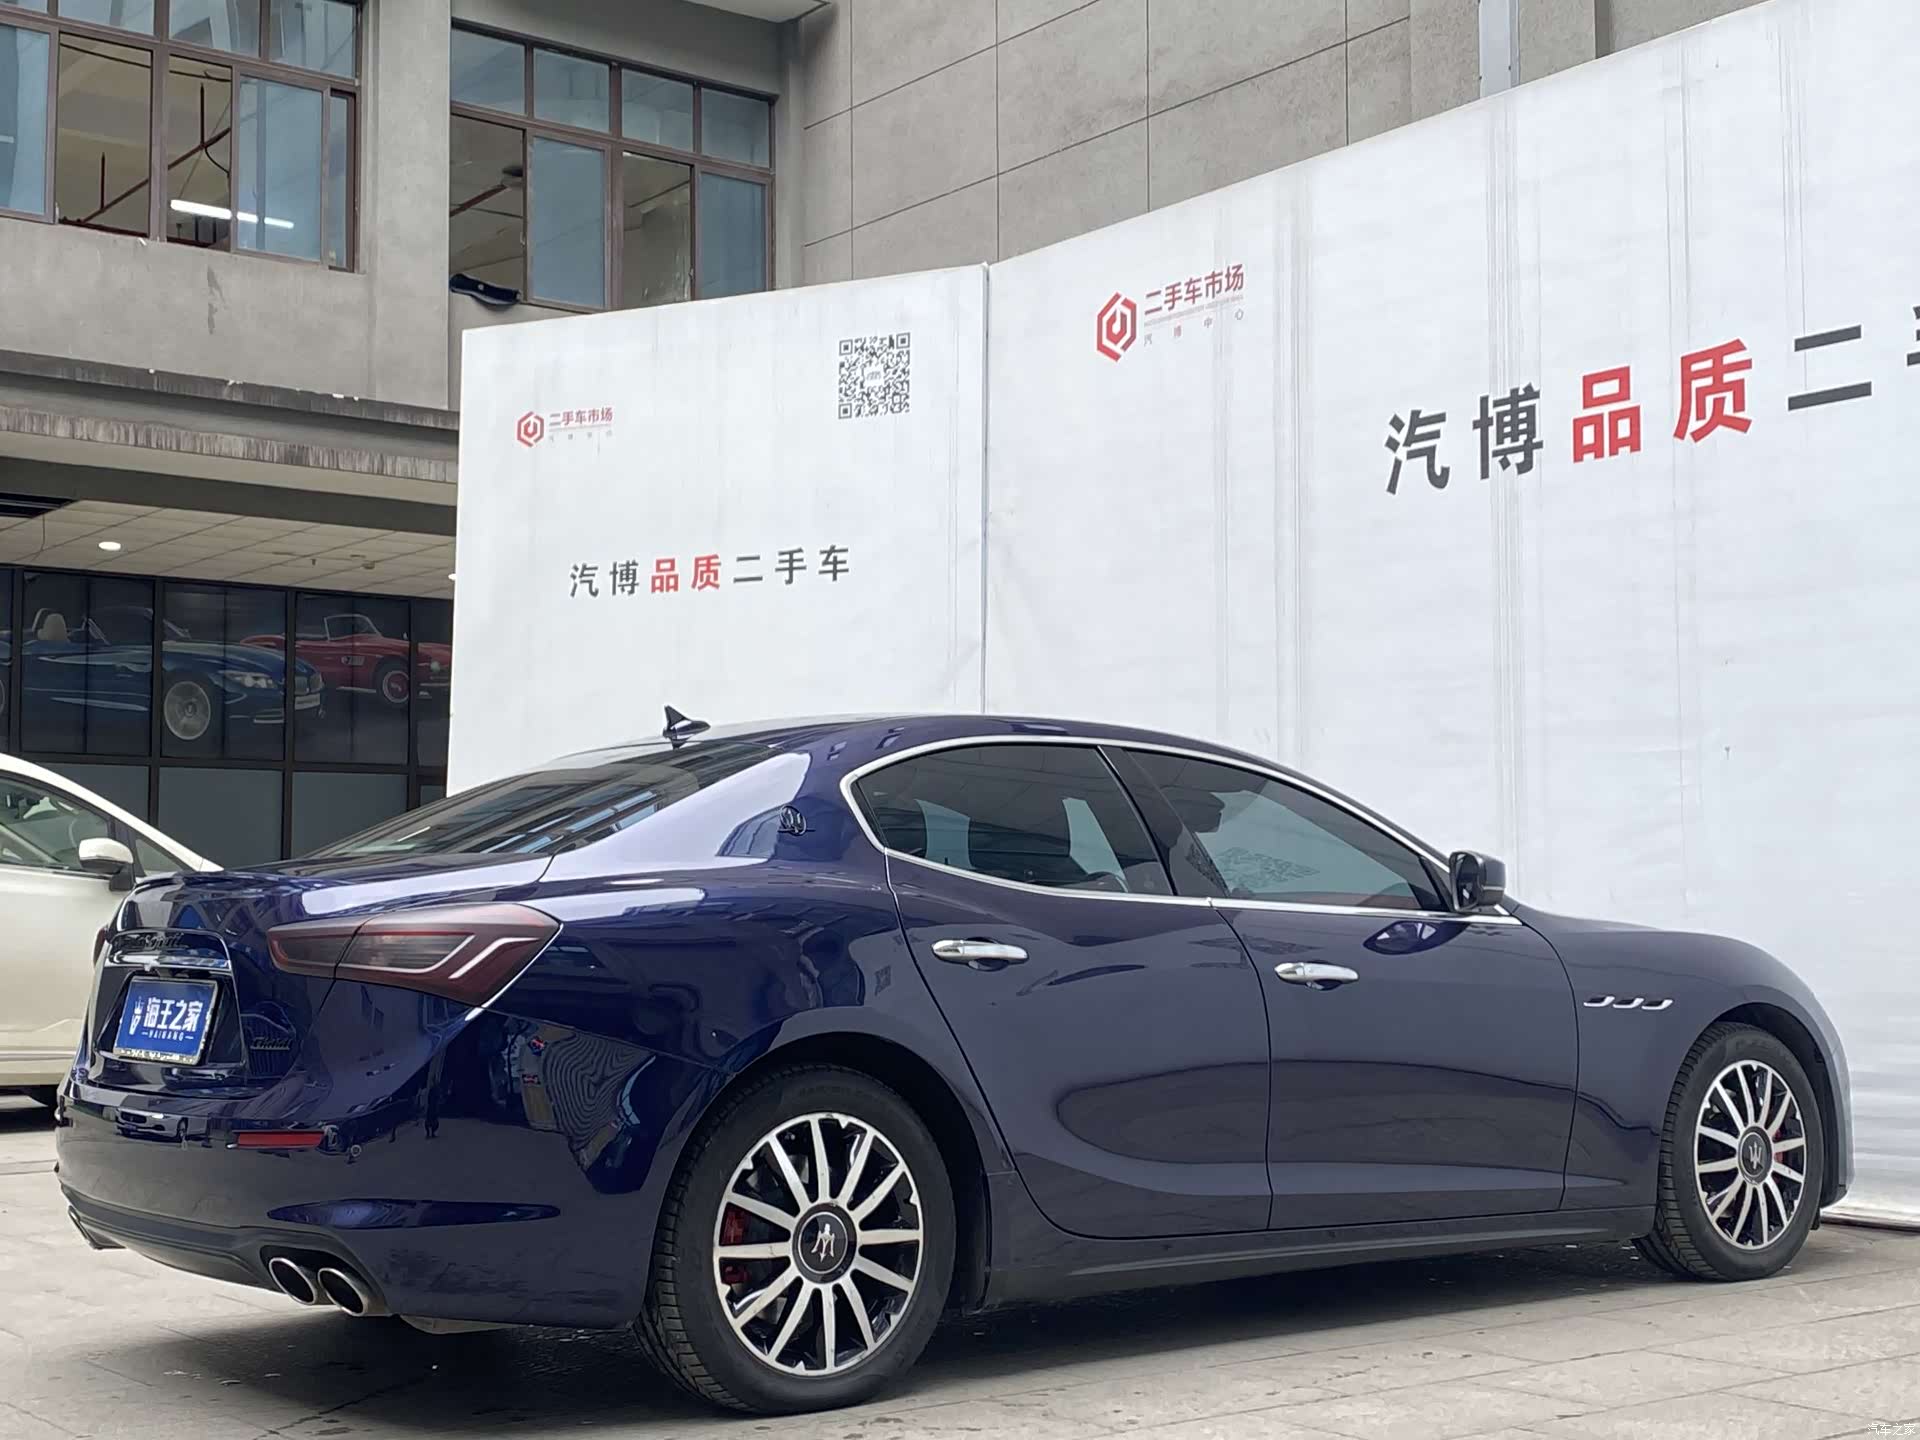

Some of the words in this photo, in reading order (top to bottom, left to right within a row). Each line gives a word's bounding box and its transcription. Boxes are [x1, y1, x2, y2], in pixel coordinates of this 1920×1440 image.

[1144, 263, 1244, 317] 二手车市场
[549, 406, 613, 426] 二手车市场
[1384, 305, 1920, 495] 汽博品质二
[569, 544, 850, 598] 汽博品质二手车
[143, 997, 204, 1032] 海王之家
